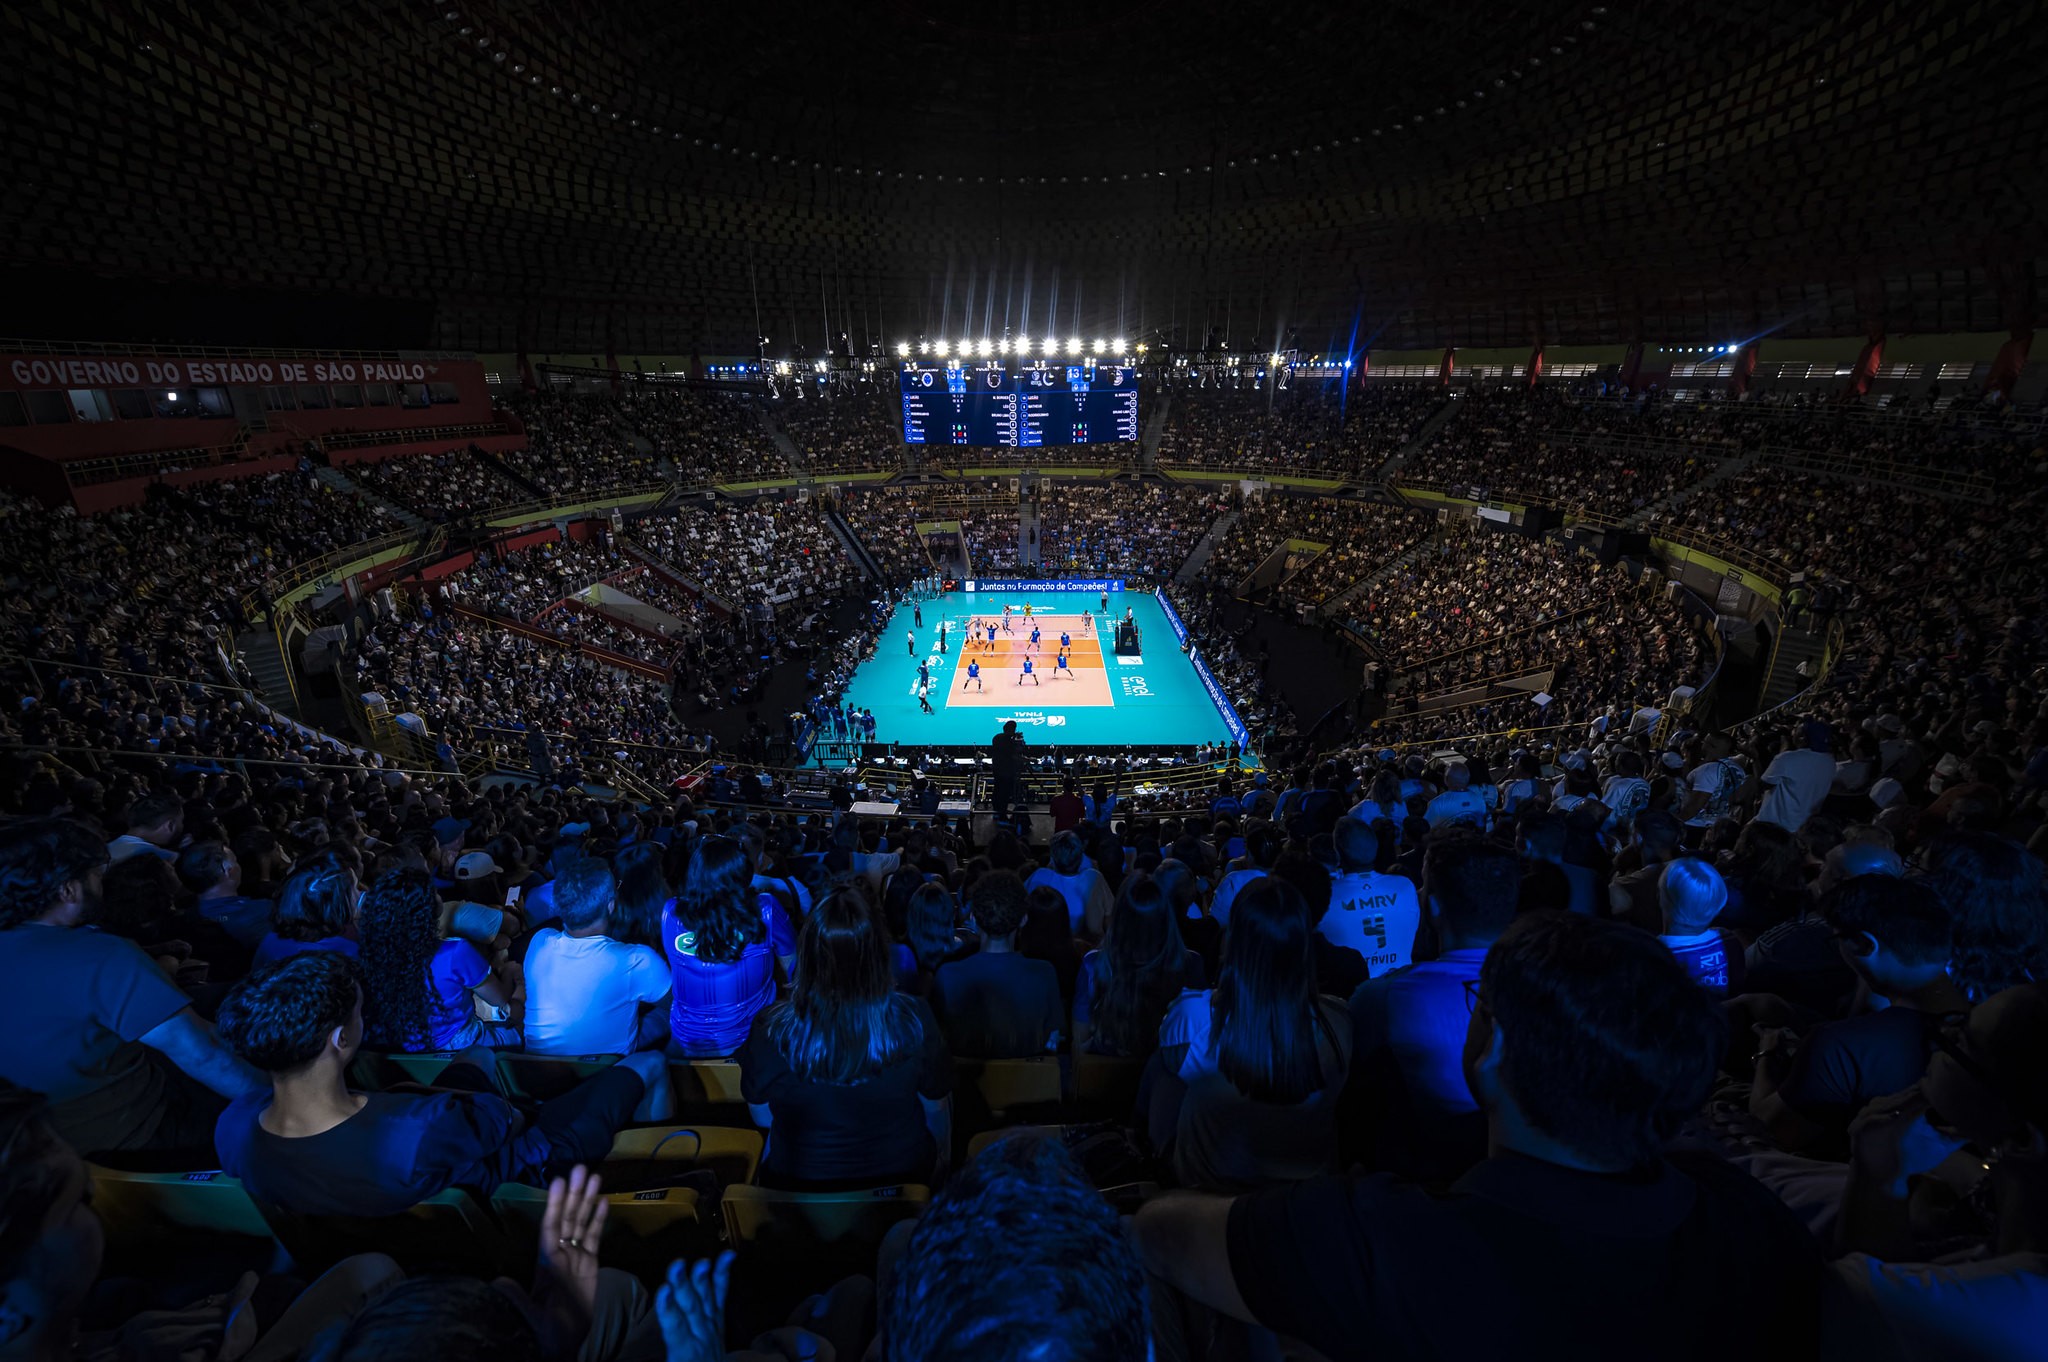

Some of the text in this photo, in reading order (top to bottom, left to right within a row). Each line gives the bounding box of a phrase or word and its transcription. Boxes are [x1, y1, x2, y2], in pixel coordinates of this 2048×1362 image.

[11, 359, 427, 385] GOVERNO DO ESTADO DE SÃO PAULO
[1067, 368, 1080, 378] 13
[980, 582, 1006, 591] Juntos
[1018, 582, 1055, 592] Formação
[1056, 582, 1066, 591] de
[1067, 582, 1108, 592] Campeões!
[1120, 676, 1132, 696] BRASIL
[1129, 676, 1156, 696] enel
[1358, 892, 1397, 910] MRV
[1362, 916, 1387, 948] 4
